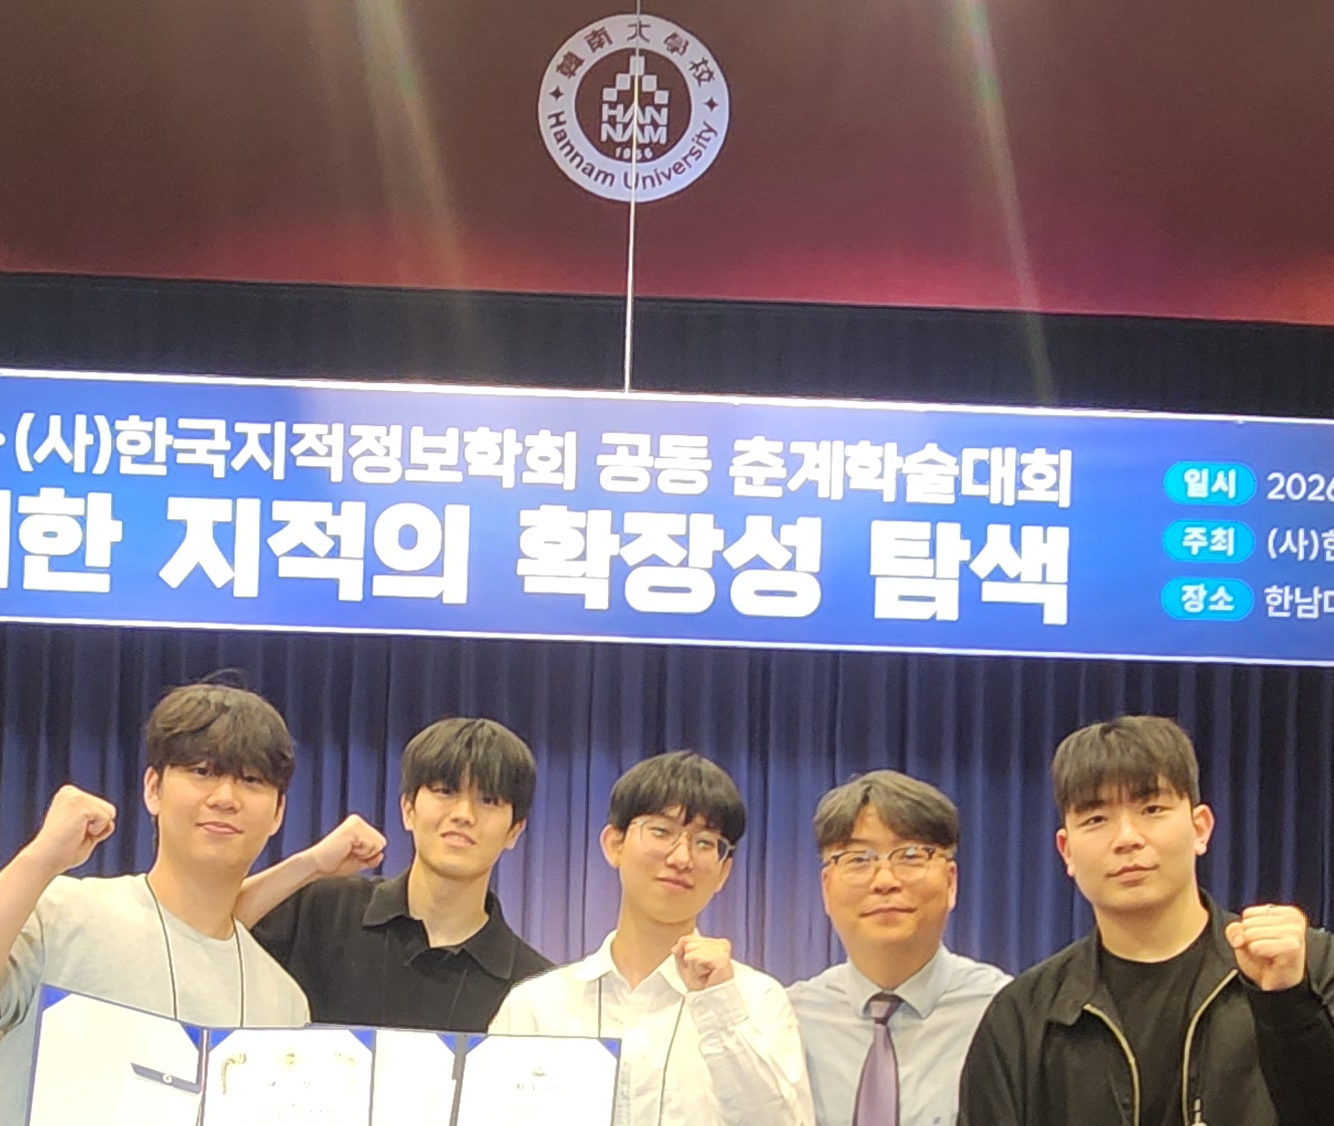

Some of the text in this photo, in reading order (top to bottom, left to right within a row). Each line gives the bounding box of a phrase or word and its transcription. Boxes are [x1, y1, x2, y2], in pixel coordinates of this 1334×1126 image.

[601, 102, 668, 126] HAN
[600, 123, 668, 145] NAM
[546, 109, 719, 191] Hannam University
[596, 431, 713, 495] 공동
[728, 435, 1073, 508] 춘계학술대회
[1183, 468, 1237, 499] 일시
[1182, 526, 1236, 557] 주최
[159, 496, 471, 604] 지적의
[516, 504, 823, 618] 확장성
[868, 519, 1071, 626] 탐색
[1181, 584, 1235, 613] 장소
